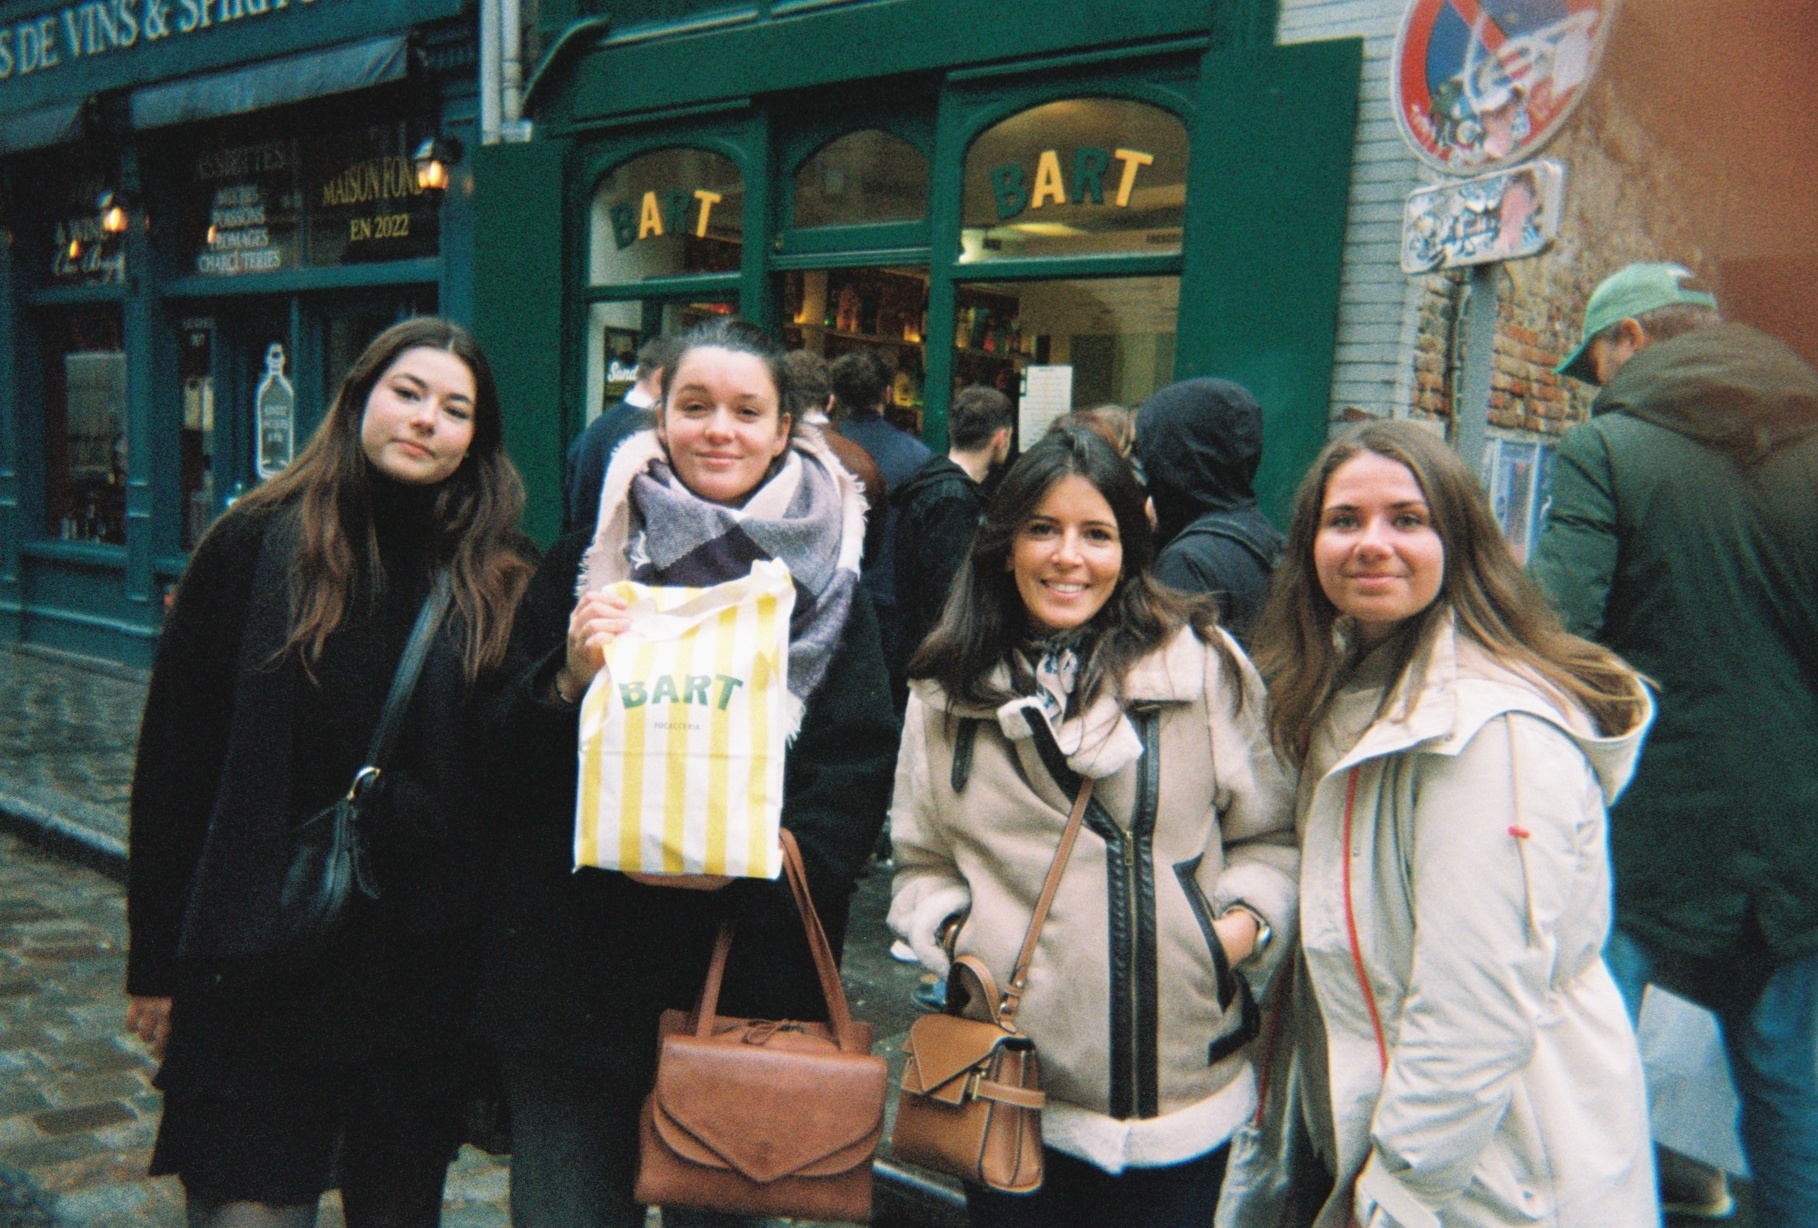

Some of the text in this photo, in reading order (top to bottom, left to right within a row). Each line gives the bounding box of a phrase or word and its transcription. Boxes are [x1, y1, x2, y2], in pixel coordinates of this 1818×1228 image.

[17, 17, 60, 75] DE
[61, 0, 138, 58] VINS
[144, 0, 170, 41] &
[322, 160, 380, 206] MAISON
[990, 147, 1153, 220] BART
[350, 214, 410, 241] EN 2022
[609, 187, 722, 250] BART
[618, 673, 744, 711] BART
